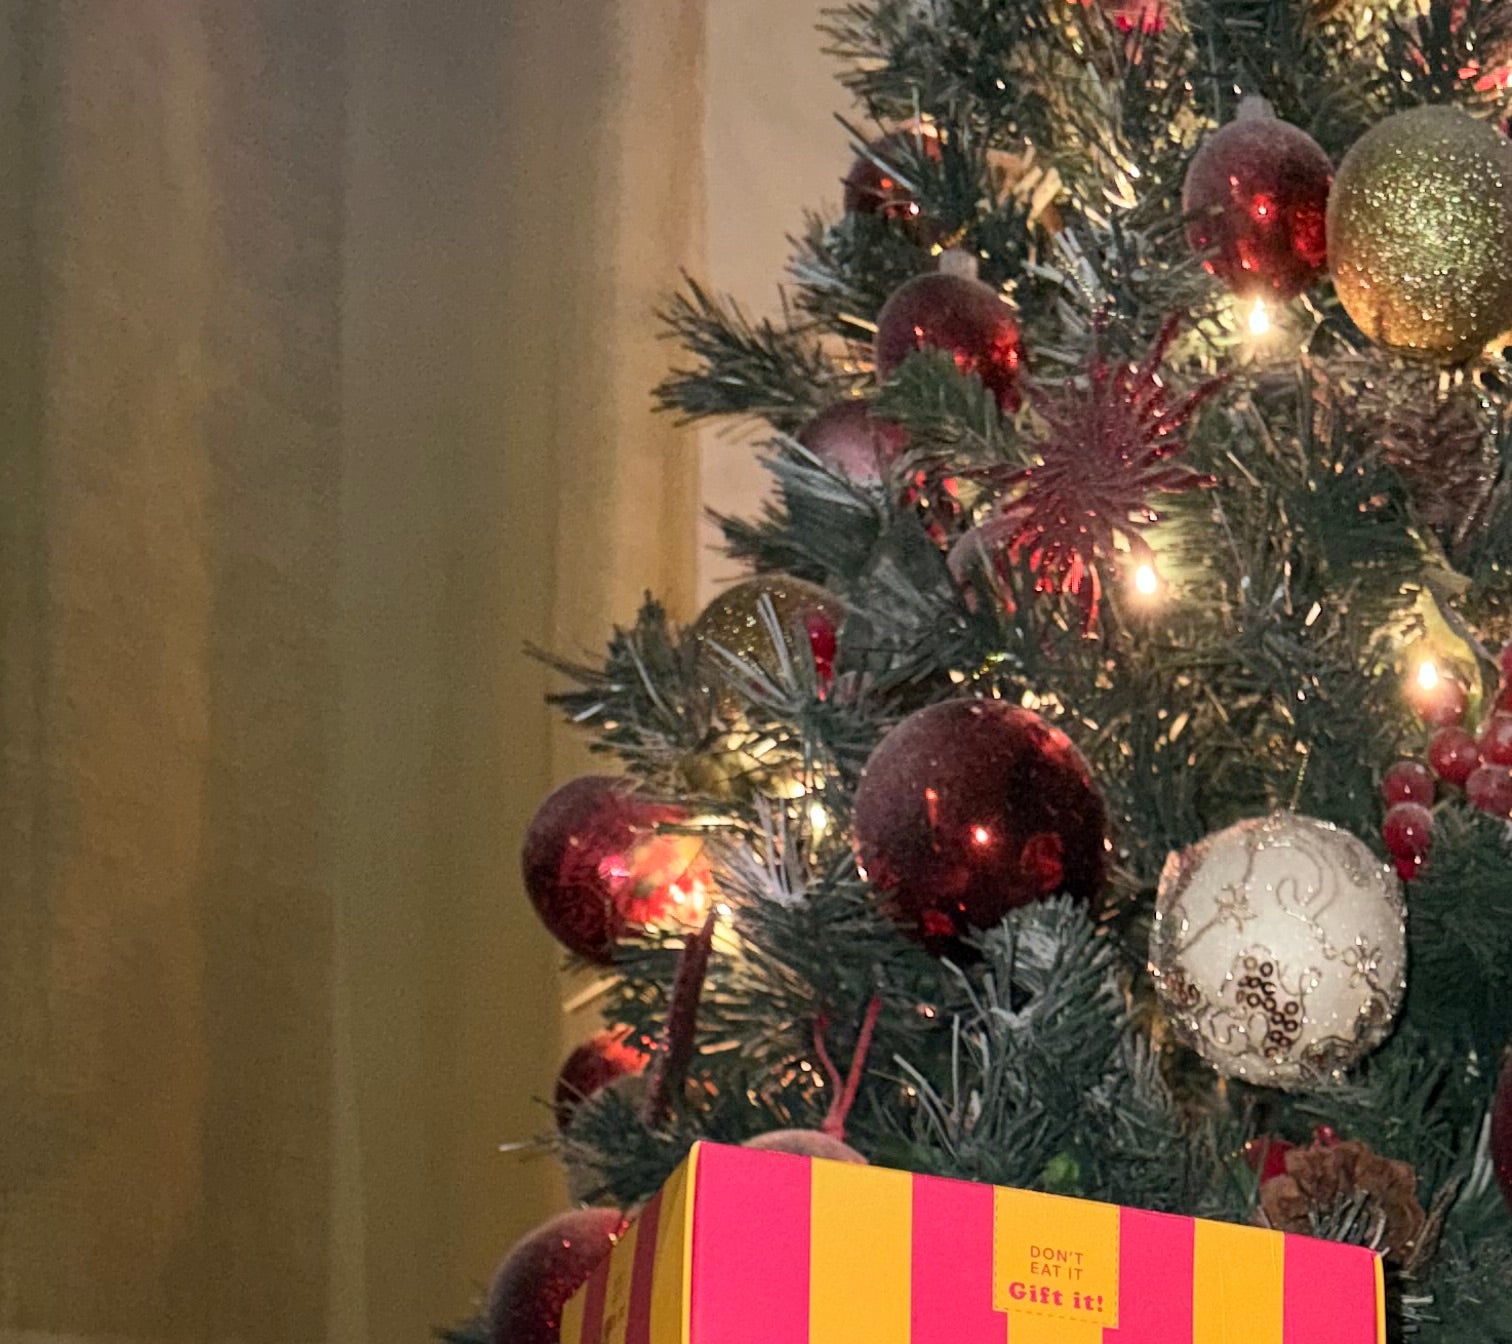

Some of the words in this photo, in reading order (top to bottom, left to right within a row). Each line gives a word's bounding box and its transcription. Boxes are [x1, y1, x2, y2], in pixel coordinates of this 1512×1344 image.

[1030, 1245, 1083, 1265] DON'T
[1031, 1262, 1061, 1277] EAT
[1069, 1267, 1083, 1280] IT
[1009, 1282, 1063, 1306] Gift
[1074, 1291, 1103, 1313] it!
